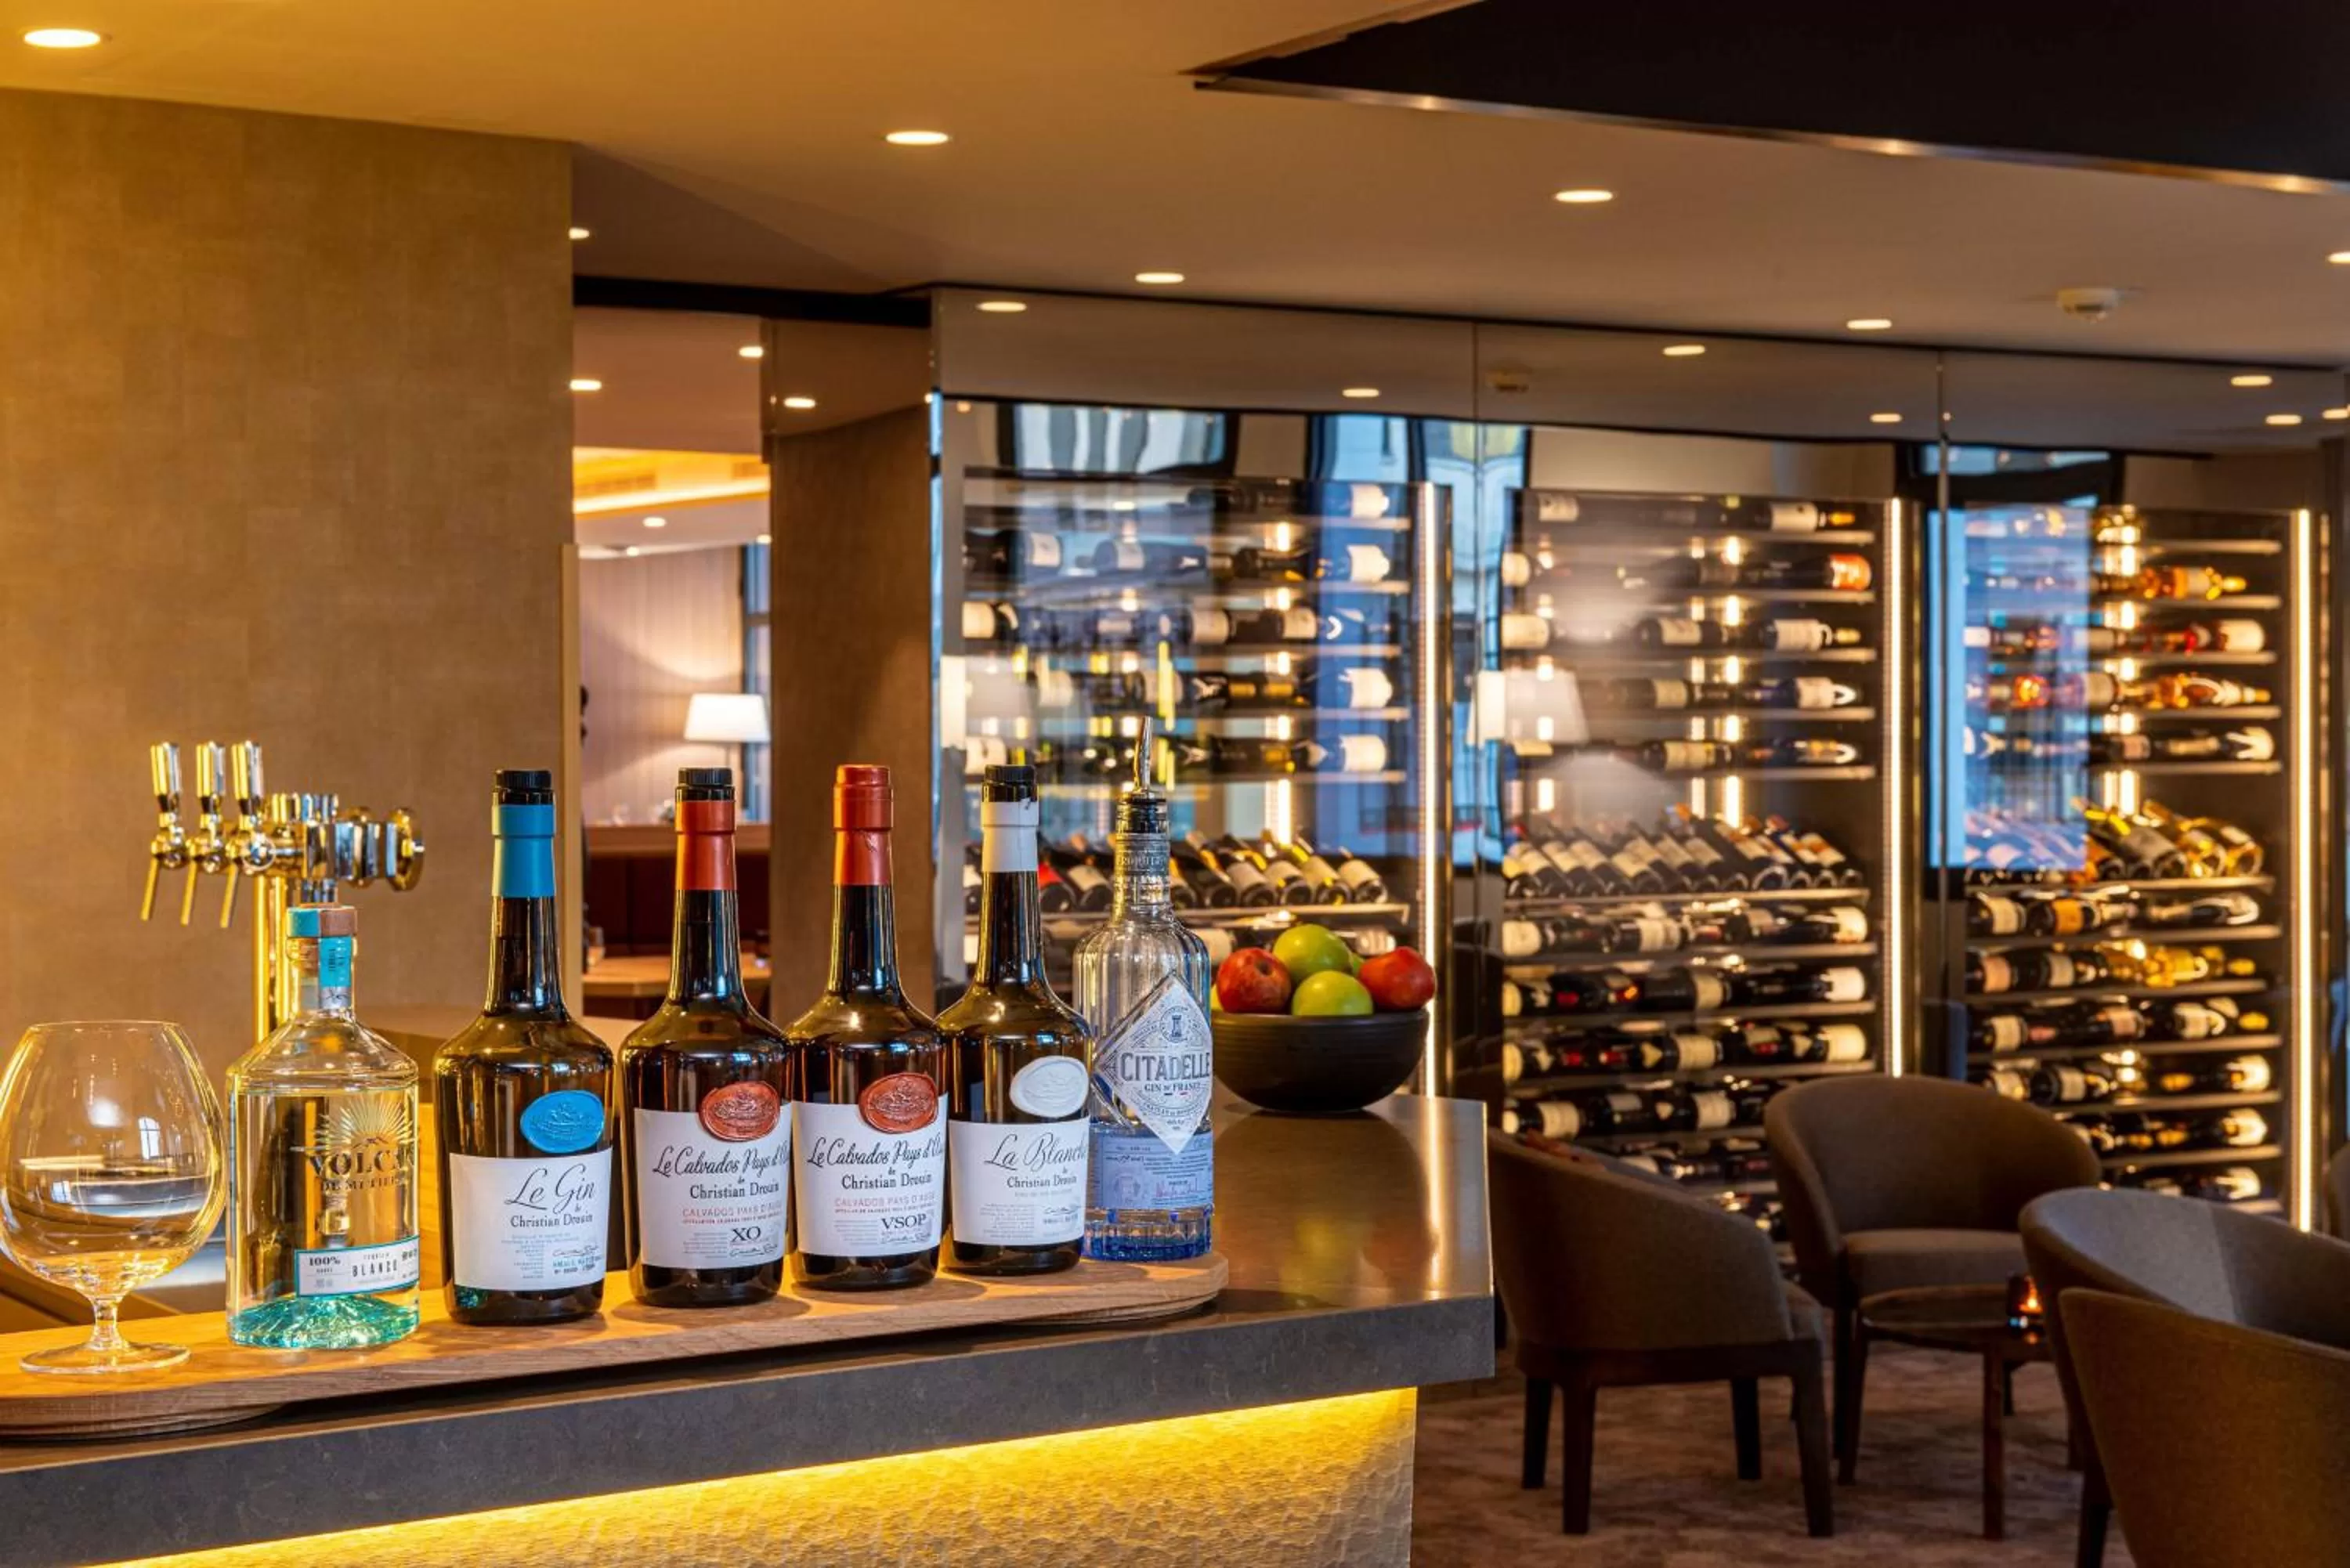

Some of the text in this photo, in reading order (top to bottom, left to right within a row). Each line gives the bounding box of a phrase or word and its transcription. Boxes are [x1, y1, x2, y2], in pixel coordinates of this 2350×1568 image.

[1120, 1053, 1210, 1082] CITADELLE
[653, 1145, 674, 1178] Le
[674, 1145, 740, 1176] Calvados
[806, 1136, 826, 1169] Le
[827, 1137, 891, 1166] Calvados
[892, 1140, 922, 1169] Pays
[984, 1133, 1018, 1171] La
[841, 1170, 932, 1190] Christian Drouin
[888, 1166, 896, 1176] de
[504, 1163, 595, 1215] Le Gin
[690, 1178, 779, 1199] Christian Drouin
[1007, 1176, 1050, 1188] Christian
[510, 1211, 593, 1228] Christian Drouin
[881, 1213, 927, 1230] VSOP
[731, 1226, 761, 1243] XO
[309, 1255, 341, 1266] 100%
[352, 1259, 398, 1277] BLANCO
